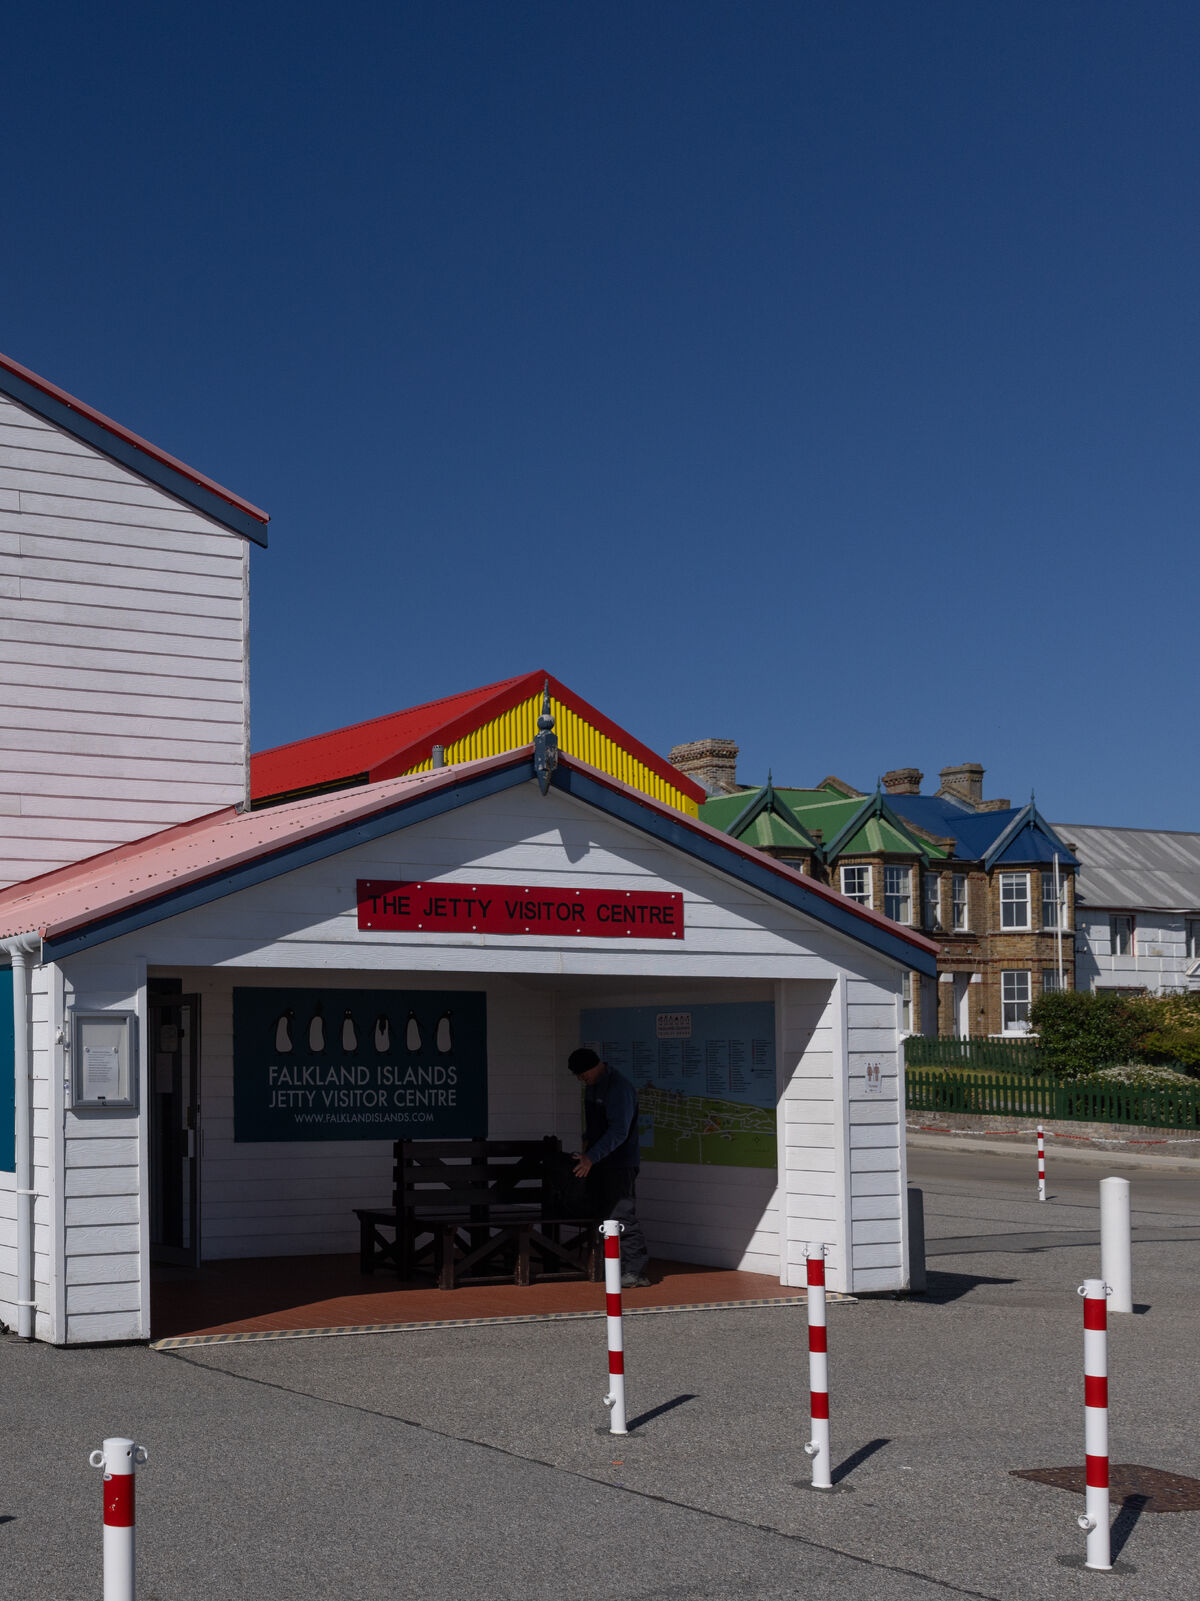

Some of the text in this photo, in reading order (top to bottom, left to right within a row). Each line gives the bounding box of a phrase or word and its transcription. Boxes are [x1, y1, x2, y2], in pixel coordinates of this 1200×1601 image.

[369, 895, 675, 925] THE JETTY VISITOR CENTRE
[268, 1066, 458, 1085] FALKLAND ISLANDS
[268, 1089, 457, 1107] JETTY VISITOR CENTRE
[294, 1112, 434, 1123] WWW.FALKLANDISLANDS.COM
